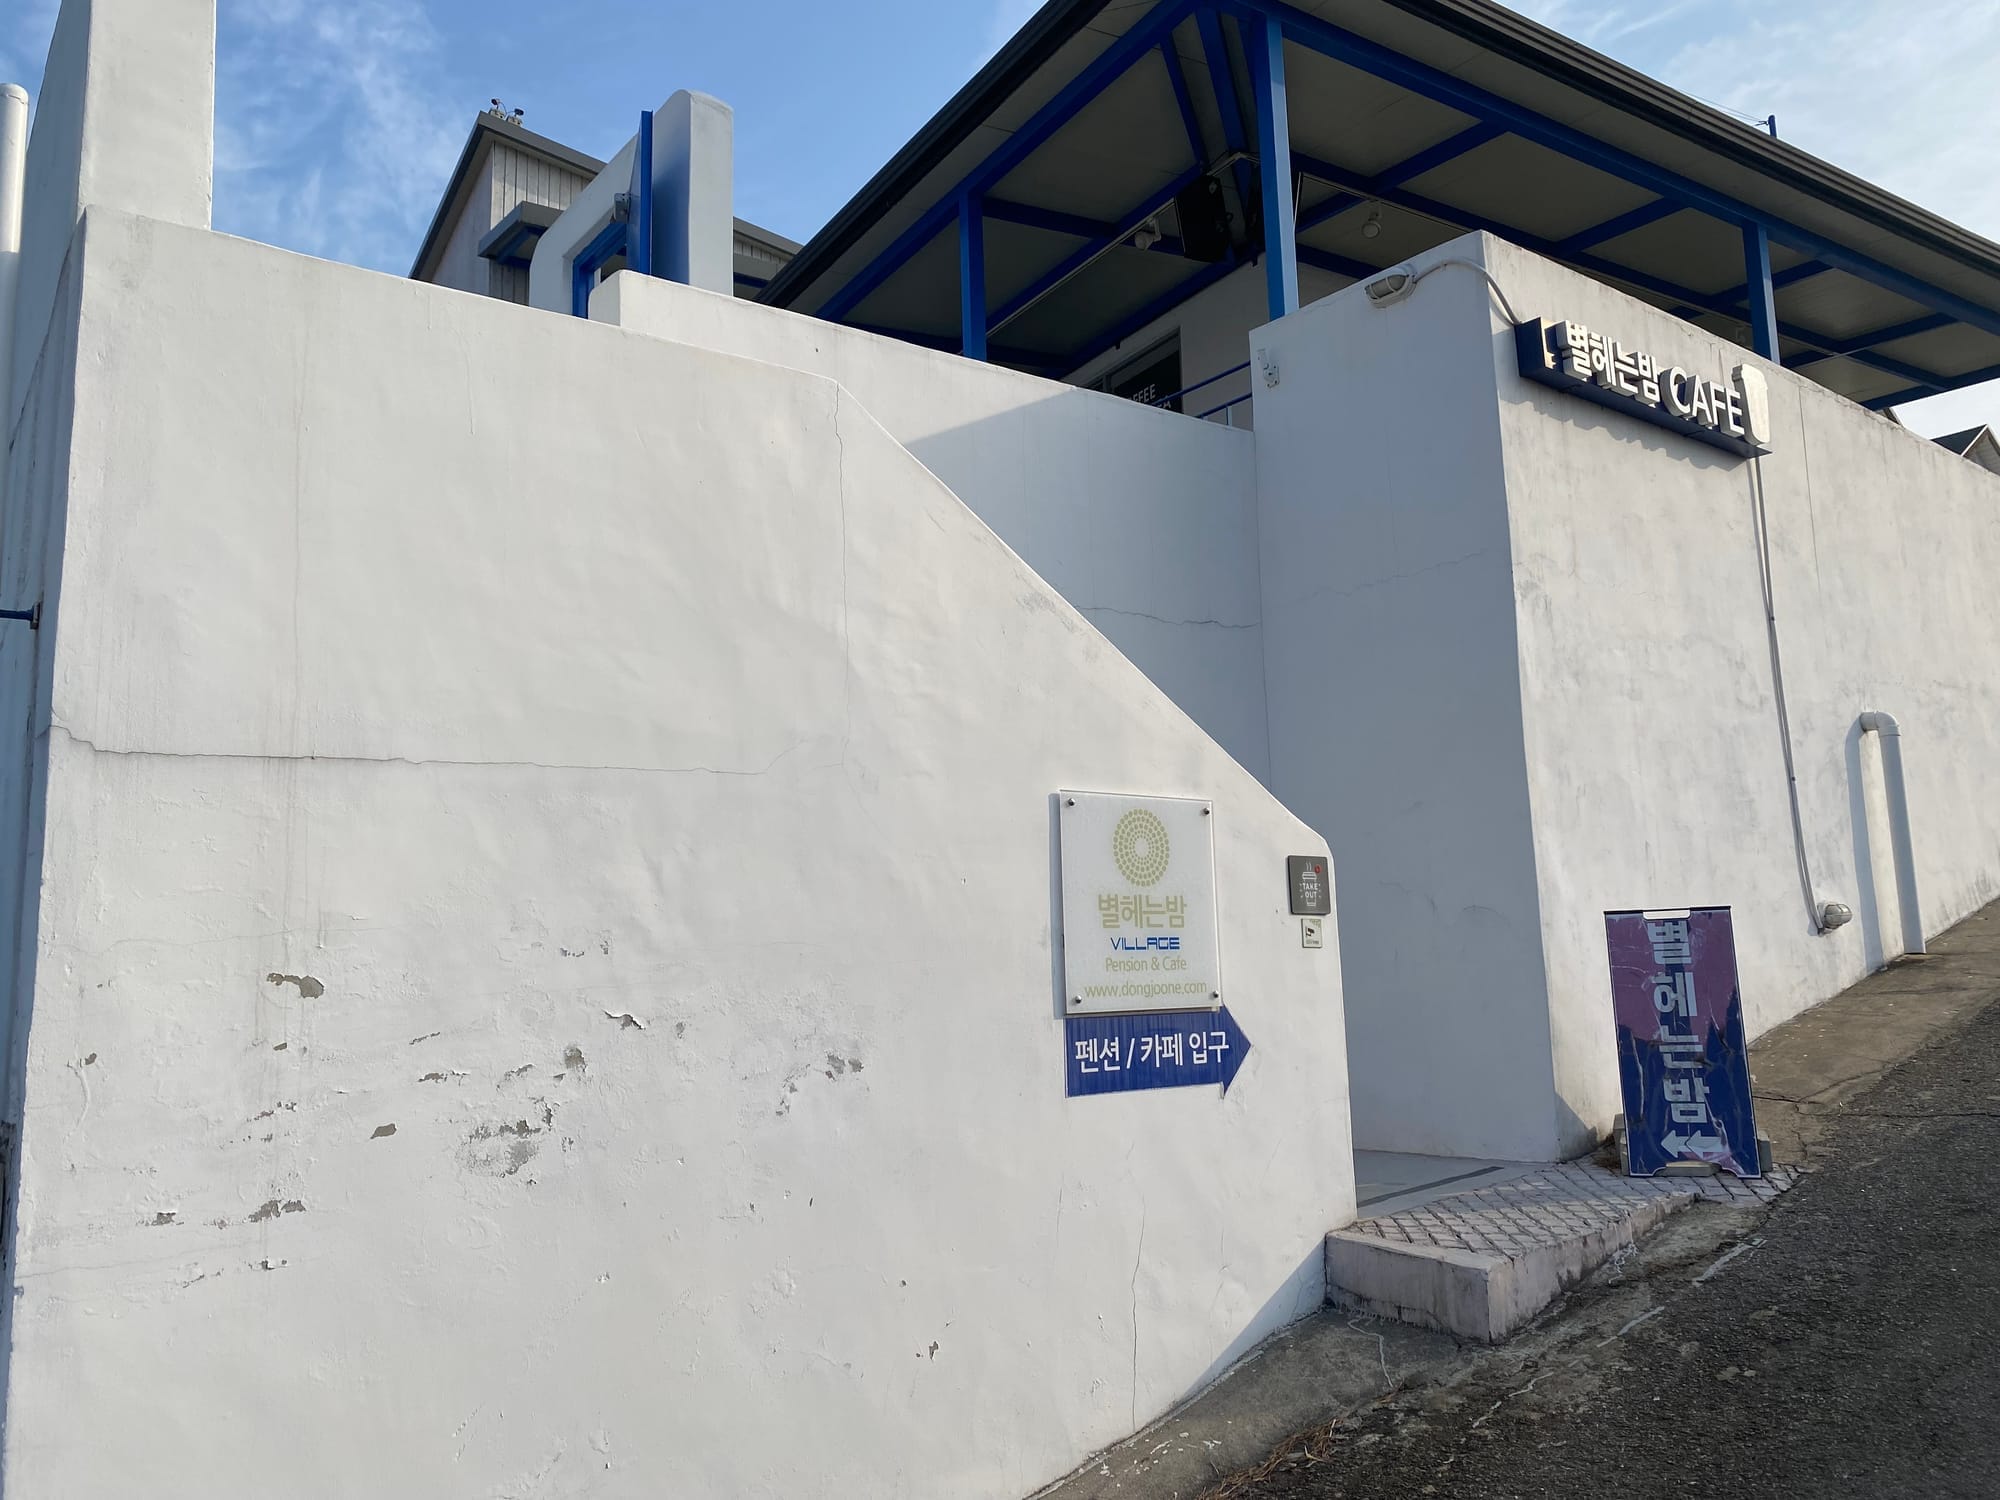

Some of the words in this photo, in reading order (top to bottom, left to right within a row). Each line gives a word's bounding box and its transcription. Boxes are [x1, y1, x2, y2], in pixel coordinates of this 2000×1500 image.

[1562, 319, 1660, 405] 별헤는밤
[1664, 365, 1745, 436] CAFE
[1302, 882, 1319, 890] TAKE
[1304, 891, 1317, 899] OUT
[1097, 894, 1187, 929] 별헤는밤
[1110, 936, 1180, 951] VILLAGE
[1105, 957, 1148, 972] Pension
[1151, 956, 1160, 971] &
[1162, 955, 1187, 970] Cafe
[1084, 980, 1207, 998] www.dongjoone.com
[1647, 920, 1711, 1124] 별헤는밤
[1075, 1037, 1121, 1073] 펜션
[1126, 1037, 1135, 1069] /
[1140, 1032, 1183, 1068] 카페
[1188, 1031, 1229, 1064] 입구
